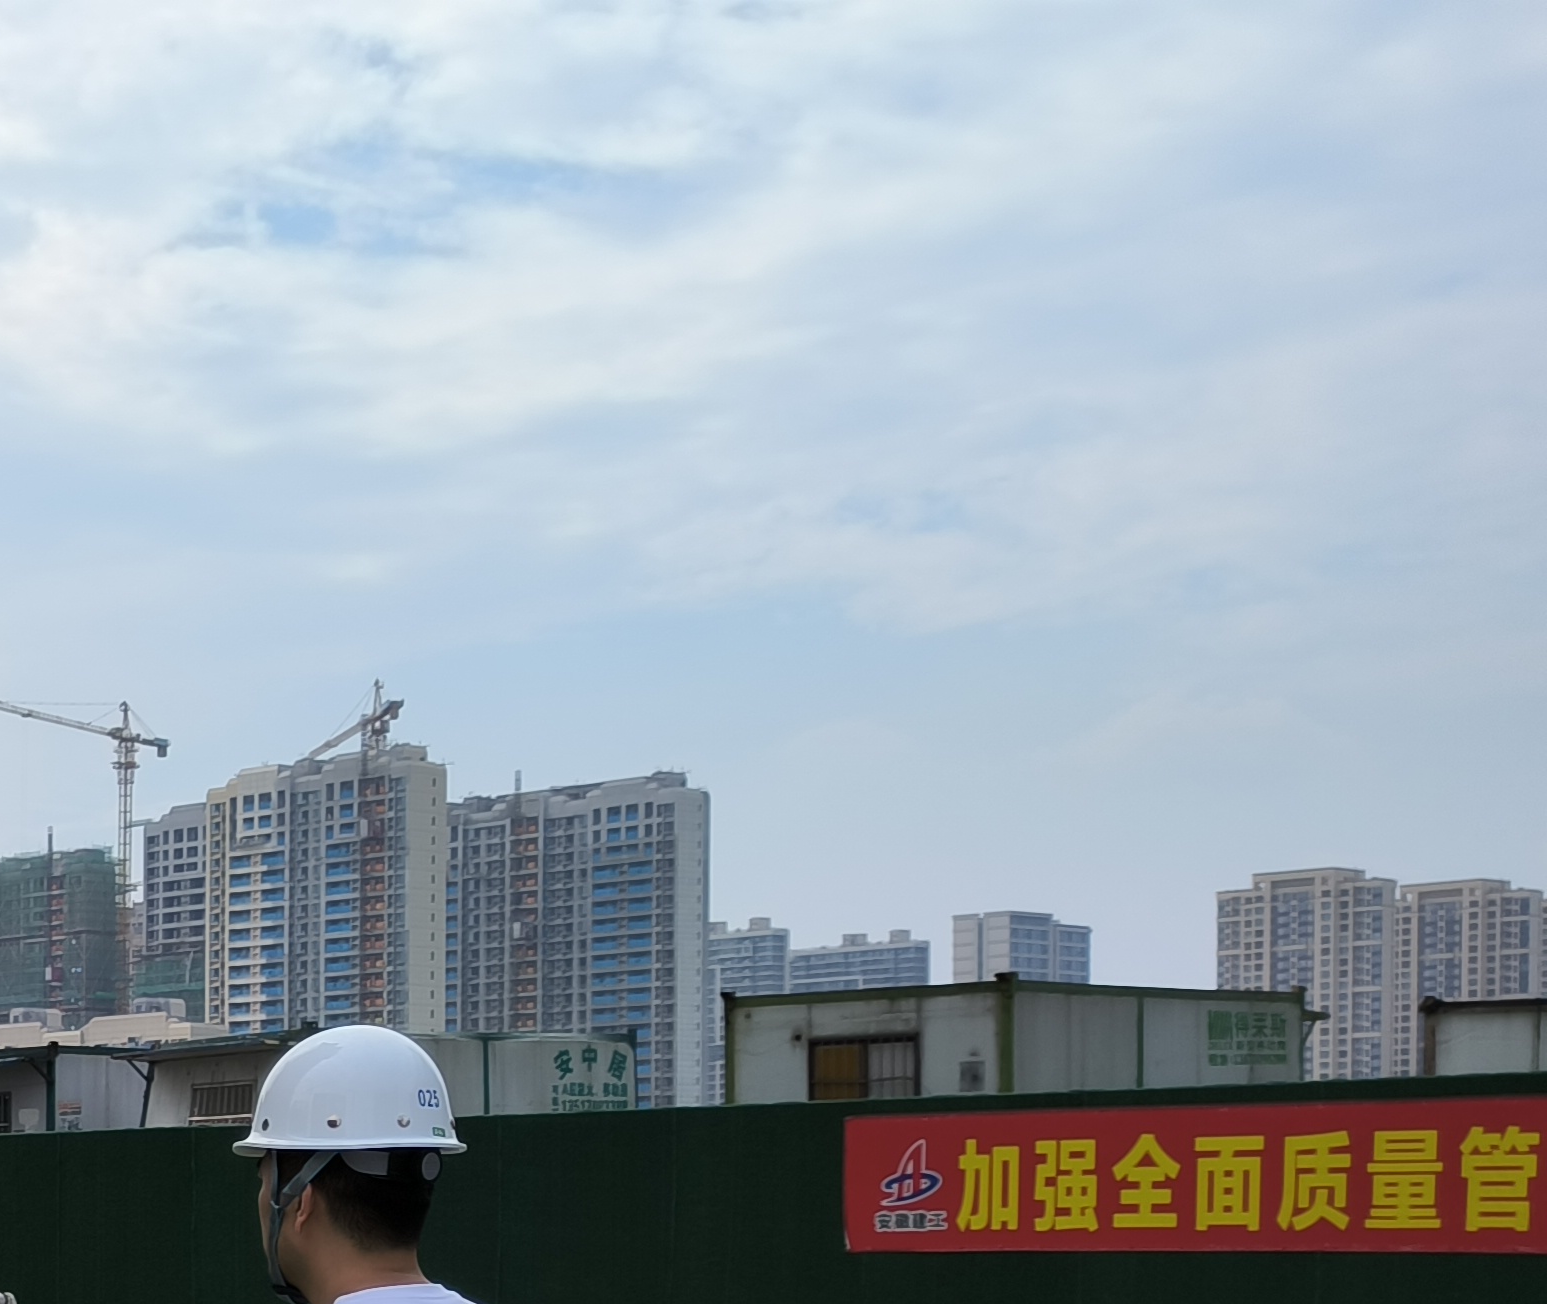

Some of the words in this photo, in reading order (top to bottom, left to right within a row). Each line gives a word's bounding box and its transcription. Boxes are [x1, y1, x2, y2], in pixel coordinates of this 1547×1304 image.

[417, 1089, 440, 1108] 025
[956, 1126, 1541, 1232] 加强全面质量管
